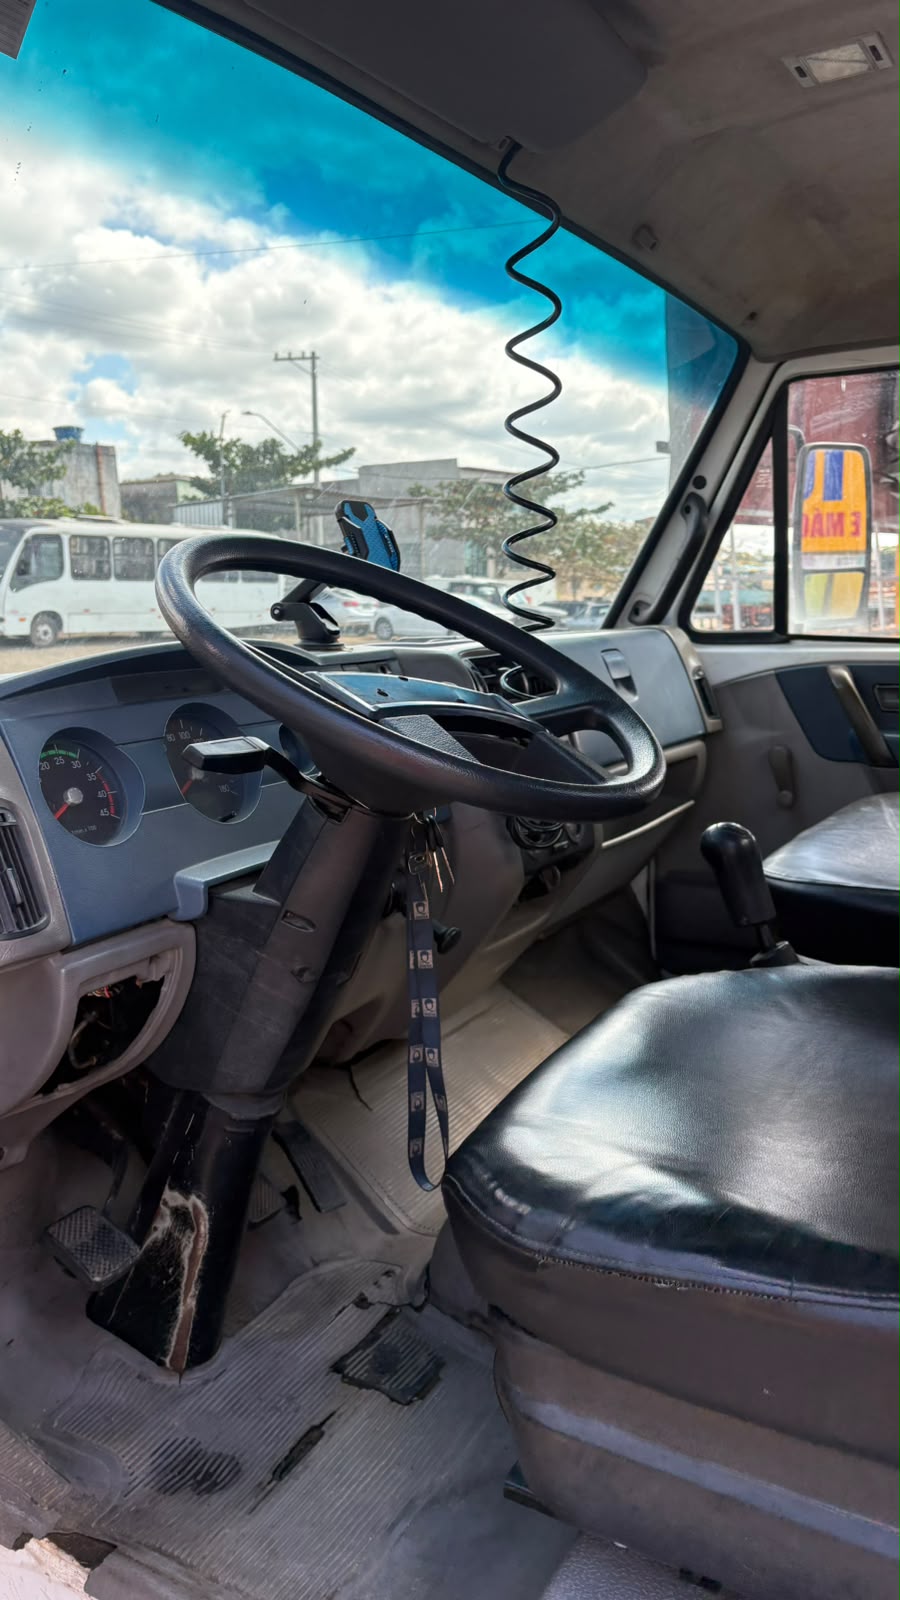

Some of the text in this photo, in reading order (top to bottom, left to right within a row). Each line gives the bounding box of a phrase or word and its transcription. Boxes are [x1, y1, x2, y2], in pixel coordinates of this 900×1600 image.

[54, 756, 65, 765] 25
[71, 760, 82, 769] 30
[40, 762, 50, 770] 20
[86, 773, 97, 782] 35
[98, 790, 108, 798] 40
[100, 808, 110, 816] 45
